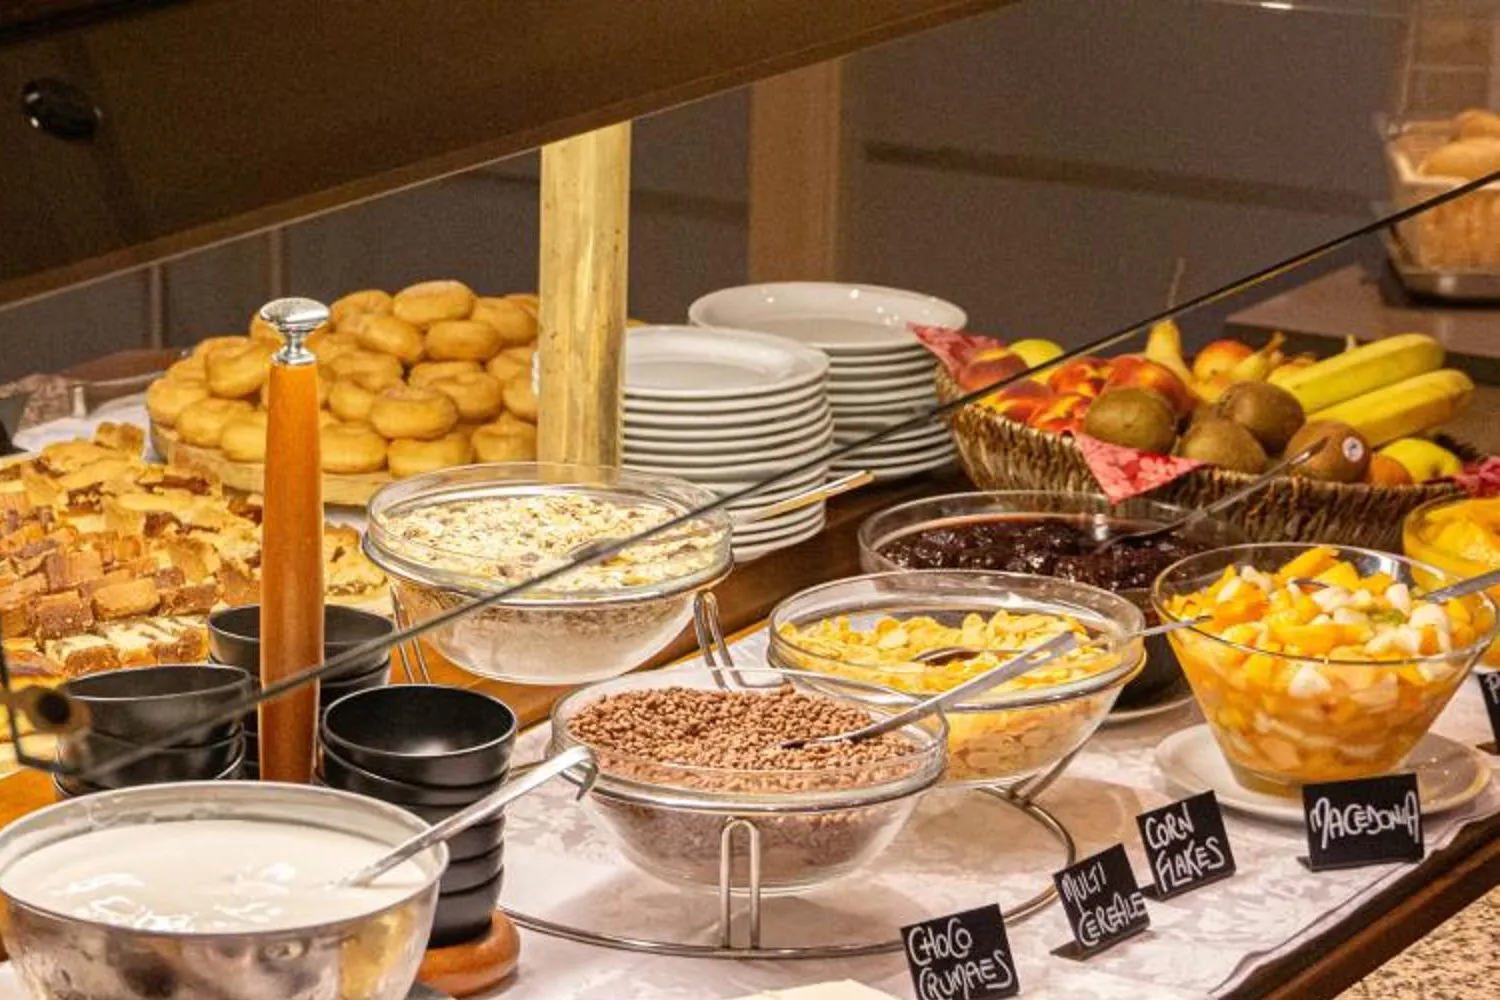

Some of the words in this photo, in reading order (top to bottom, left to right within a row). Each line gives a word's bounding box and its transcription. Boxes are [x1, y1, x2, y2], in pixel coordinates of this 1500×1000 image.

[1145, 801, 1194, 849] CORN
[1061, 862, 1107, 913] MULTI
[1155, 840, 1225, 892] FLAKES
[908, 917, 973, 966] CHOCO
[1078, 891, 1148, 947] CEREALE
